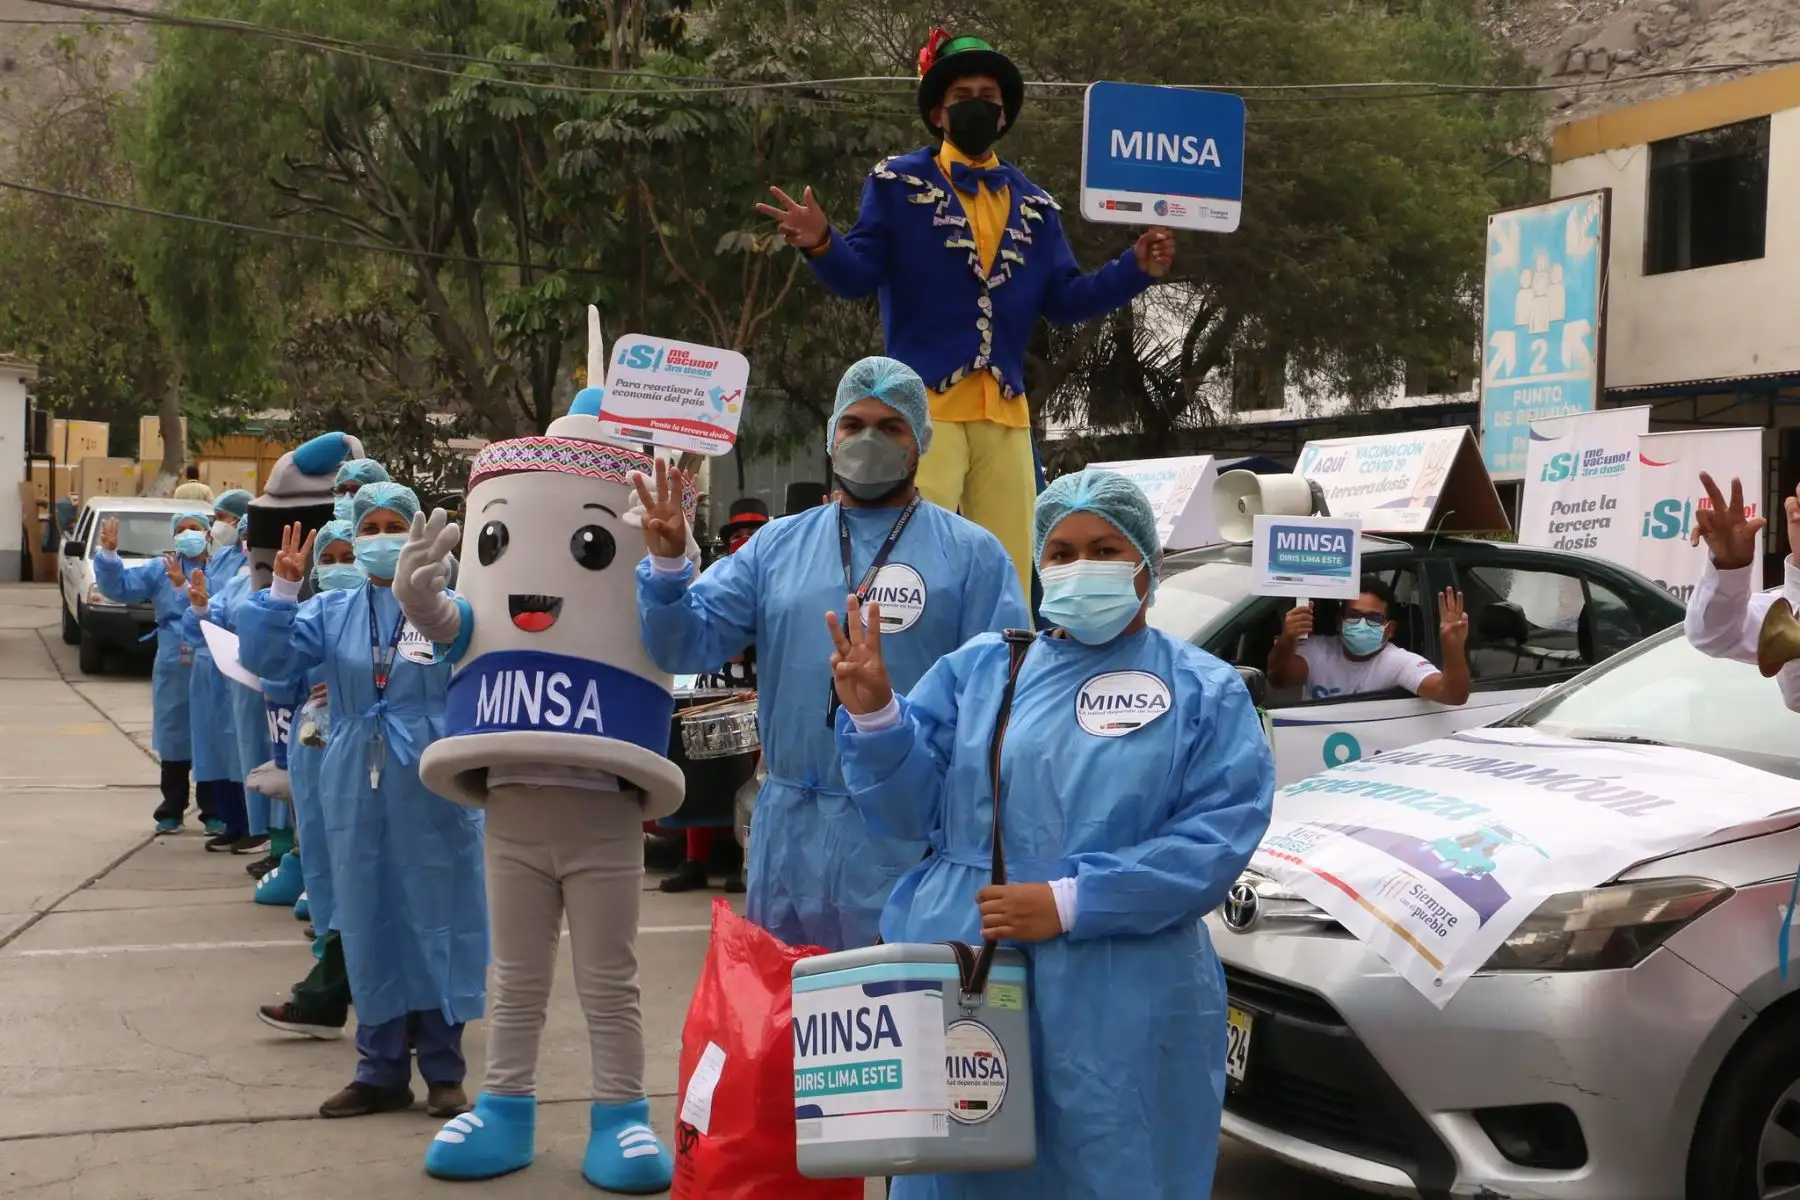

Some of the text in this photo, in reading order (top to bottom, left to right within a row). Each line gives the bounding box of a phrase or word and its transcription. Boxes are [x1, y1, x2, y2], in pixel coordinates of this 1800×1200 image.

[1110, 129, 1221, 168] MINSA
[666, 356, 719, 370] vacuno!
[669, 348, 690, 358] me
[1529, 338, 1548, 375] 2
[683, 366, 713, 377] dosis
[612, 389, 705, 407] economía del país
[616, 379, 705, 397] Para reactivar la
[1513, 386, 1562, 407] PUNTO
[1494, 410, 1512, 427] DE
[650, 420, 671, 429] Ponte
[681, 425, 708, 437] tercera
[709, 430, 729, 440] dosis
[1355, 439, 1426, 460] VACUNACIÓN
[1583, 451, 1631, 467] vacuno!
[1584, 448, 1604, 459] me
[1312, 451, 1348, 473] AQUÍ
[1359, 458, 1393, 474] COVID
[1599, 464, 1626, 475] dosis
[1331, 483, 1376, 500] tercera
[1375, 474, 1411, 495] dosis
[1550, 495, 1617, 516] Ponte la
[1548, 515, 1611, 534] tercera
[1277, 532, 1347, 553] MINSA
[1554, 534, 1598, 550] dosis
[1301, 555, 1320, 563] LIMA
[1322, 556, 1342, 565] ESTE
[864, 587, 923, 605] MINSA
[475, 669, 604, 733] MINSA
[1080, 691, 1167, 711] MINSA
[1409, 883, 1458, 928] Siempre
[1411, 906, 1448, 938] pueblo
[792, 1004, 903, 1058] MINSA
[794, 1064, 898, 1092] DIRIS LIMA ESTE
